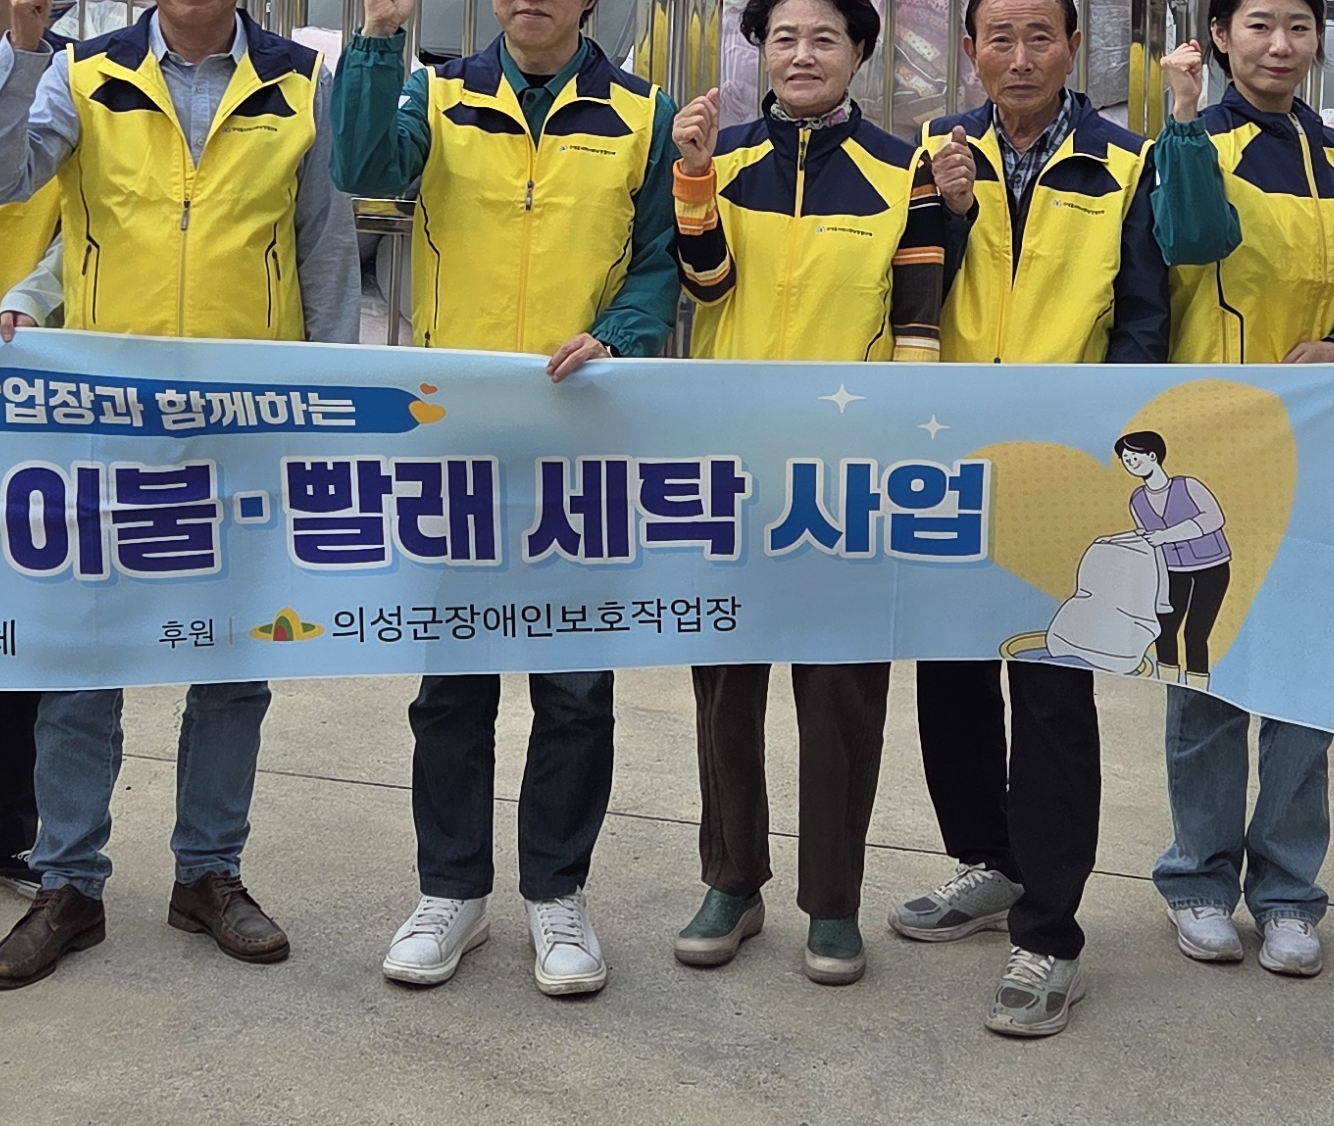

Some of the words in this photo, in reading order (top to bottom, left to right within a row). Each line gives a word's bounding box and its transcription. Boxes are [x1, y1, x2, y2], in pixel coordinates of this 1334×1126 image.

[160, 386, 357, 430] 함께하는
[525, 452, 750, 562] 세탁
[767, 457, 992, 561] 사업
[158, 616, 216, 649] 후원
[330, 598, 742, 645] 의성군장애인보호작업장
